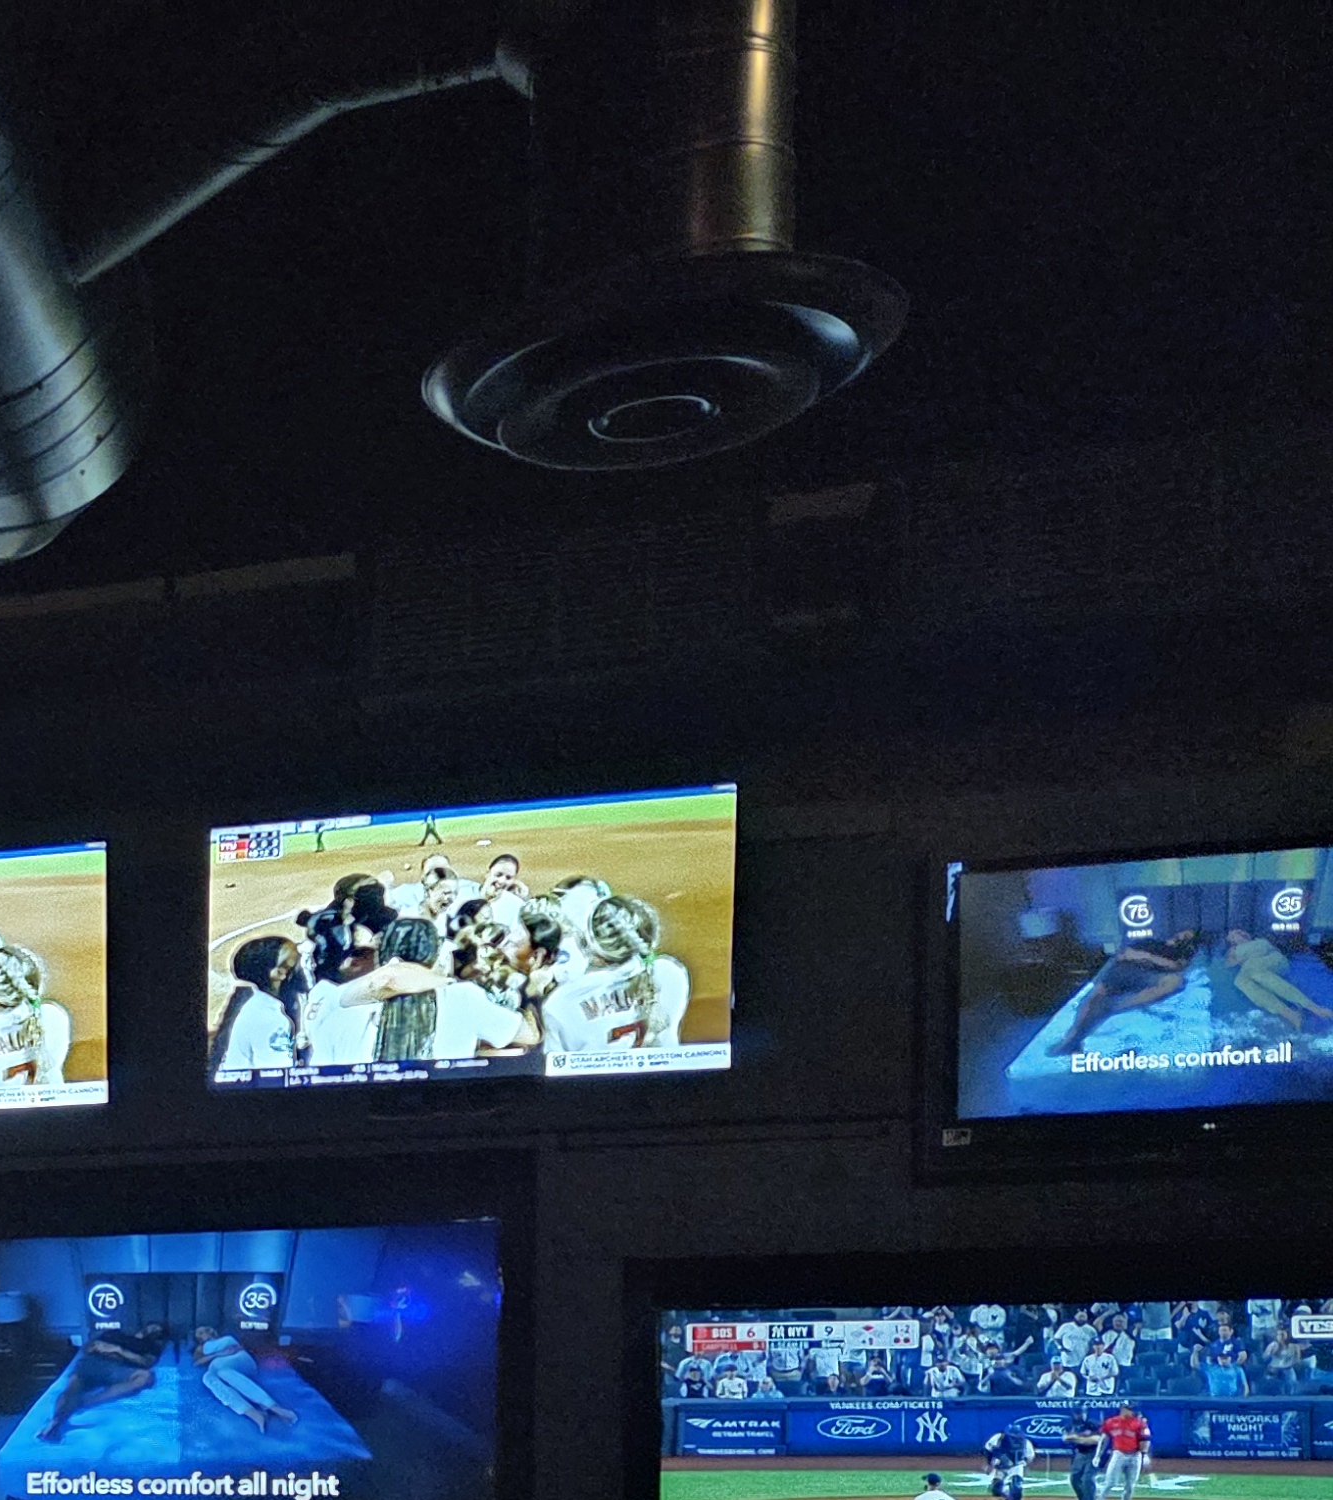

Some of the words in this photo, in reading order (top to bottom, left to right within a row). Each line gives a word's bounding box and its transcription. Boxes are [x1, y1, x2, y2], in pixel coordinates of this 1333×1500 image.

[1277, 896, 1303, 913] 35
[1071, 1050, 1170, 1073] Effortless
[1174, 1045, 1262, 1067] comfort
[1265, 1041, 1292, 1063] all
[95, 1292, 117, 1310] 75
[244, 1292, 270, 1309] 35
[711, 1327, 734, 1339] BOS
[746, 1326, 756, 1339] 6
[787, 1326, 808, 1338] NYY
[824, 1326, 834, 1338] 9
[894, 1324, 911, 1334] 1-2
[711, 1420, 781, 1429] AMTRAK
[830, 1418, 878, 1436] Ford
[1211, 1413, 1281, 1424] FIREWORKS
[1227, 1422, 1265, 1432] NIGHT
[26, 1471, 133, 1495] Effortless
[137, 1471, 235, 1495] comfort
[238, 1472, 266, 1495] all
